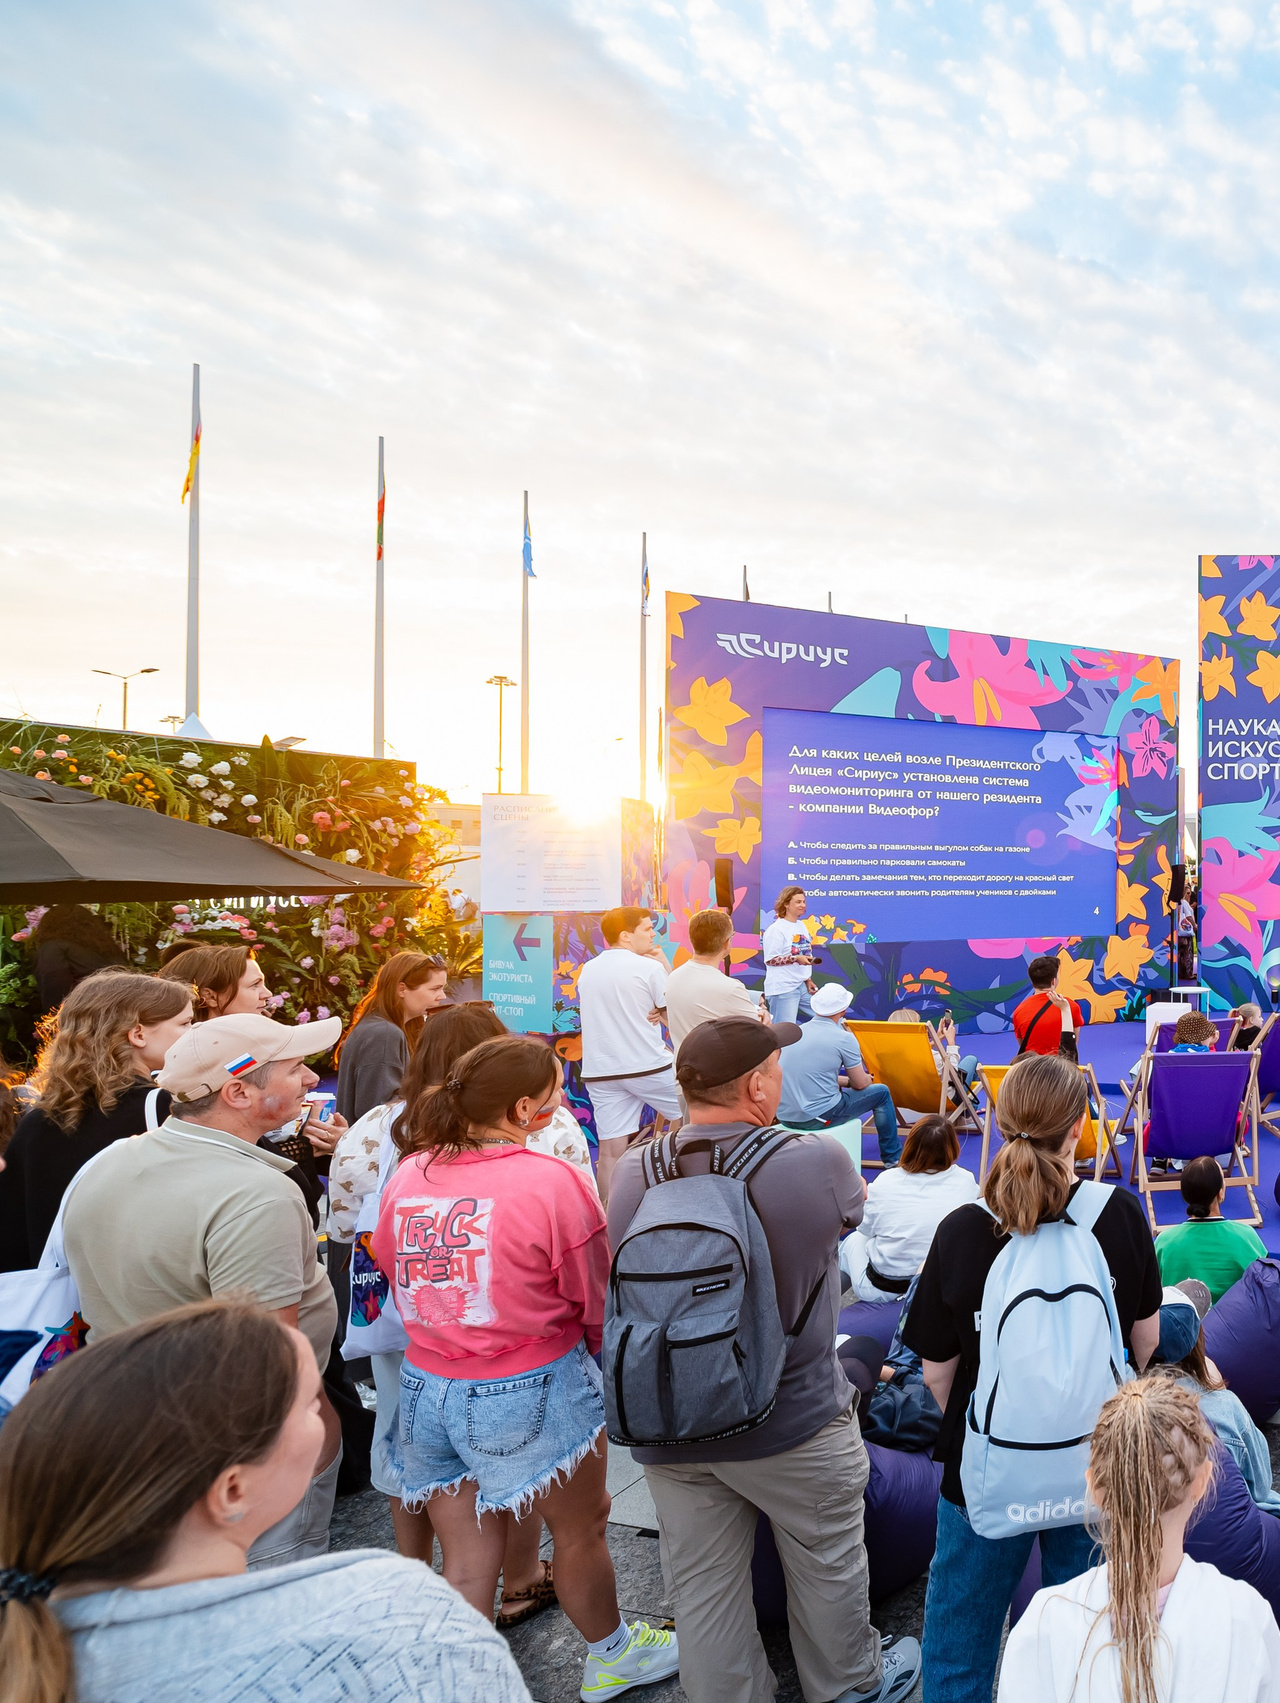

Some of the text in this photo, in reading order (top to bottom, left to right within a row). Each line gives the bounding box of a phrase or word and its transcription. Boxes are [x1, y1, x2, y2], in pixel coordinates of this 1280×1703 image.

[738, 632, 849, 668] Сириус
[788, 745, 1041, 772] Для каких целей возле Президентского
[788, 763, 1030, 787] Лицея «Сириус» установлена система
[788, 784, 1042, 804] видеомониторинга от нашего резидента
[799, 803, 864, 814] компании
[868, 803, 940, 819] Видеофор?
[493, 814, 529, 822] СЦЕНЫ
[787, 841, 798, 849] А.
[799, 841, 829, 849] Чтобы
[830, 842, 867, 851] следить
[879, 843, 933, 851] правильным
[934, 844, 969, 853] выгулом
[787, 857, 966, 867] Б. Чтобы правильно парковали самокаты
[787, 873, 797, 881] В.
[799, 873, 828, 881] Чтобы
[829, 874, 861, 882] делать
[909, 874, 927, 882] тем,
[1025, 874, 1057, 882] красный
[803, 889, 827, 897] тобы
[828, 889, 894, 897] автоматически
[931, 889, 975, 897] родителям
[976, 889, 1013, 897] учеников
[1019, 888, 1057, 896] двойками
[1093, 906, 1100, 916] 4
[488, 960, 515, 970] БИВУАК
[488, 972, 533, 983] ЭКОТУРИСТА
[488, 992, 536, 1004] СПОРТИВНЫЙ
[490, 1005, 524, 1016] ИТ-СТОП
[429, 1245, 454, 1259] OR
[396, 1248, 486, 1289] TREAT
